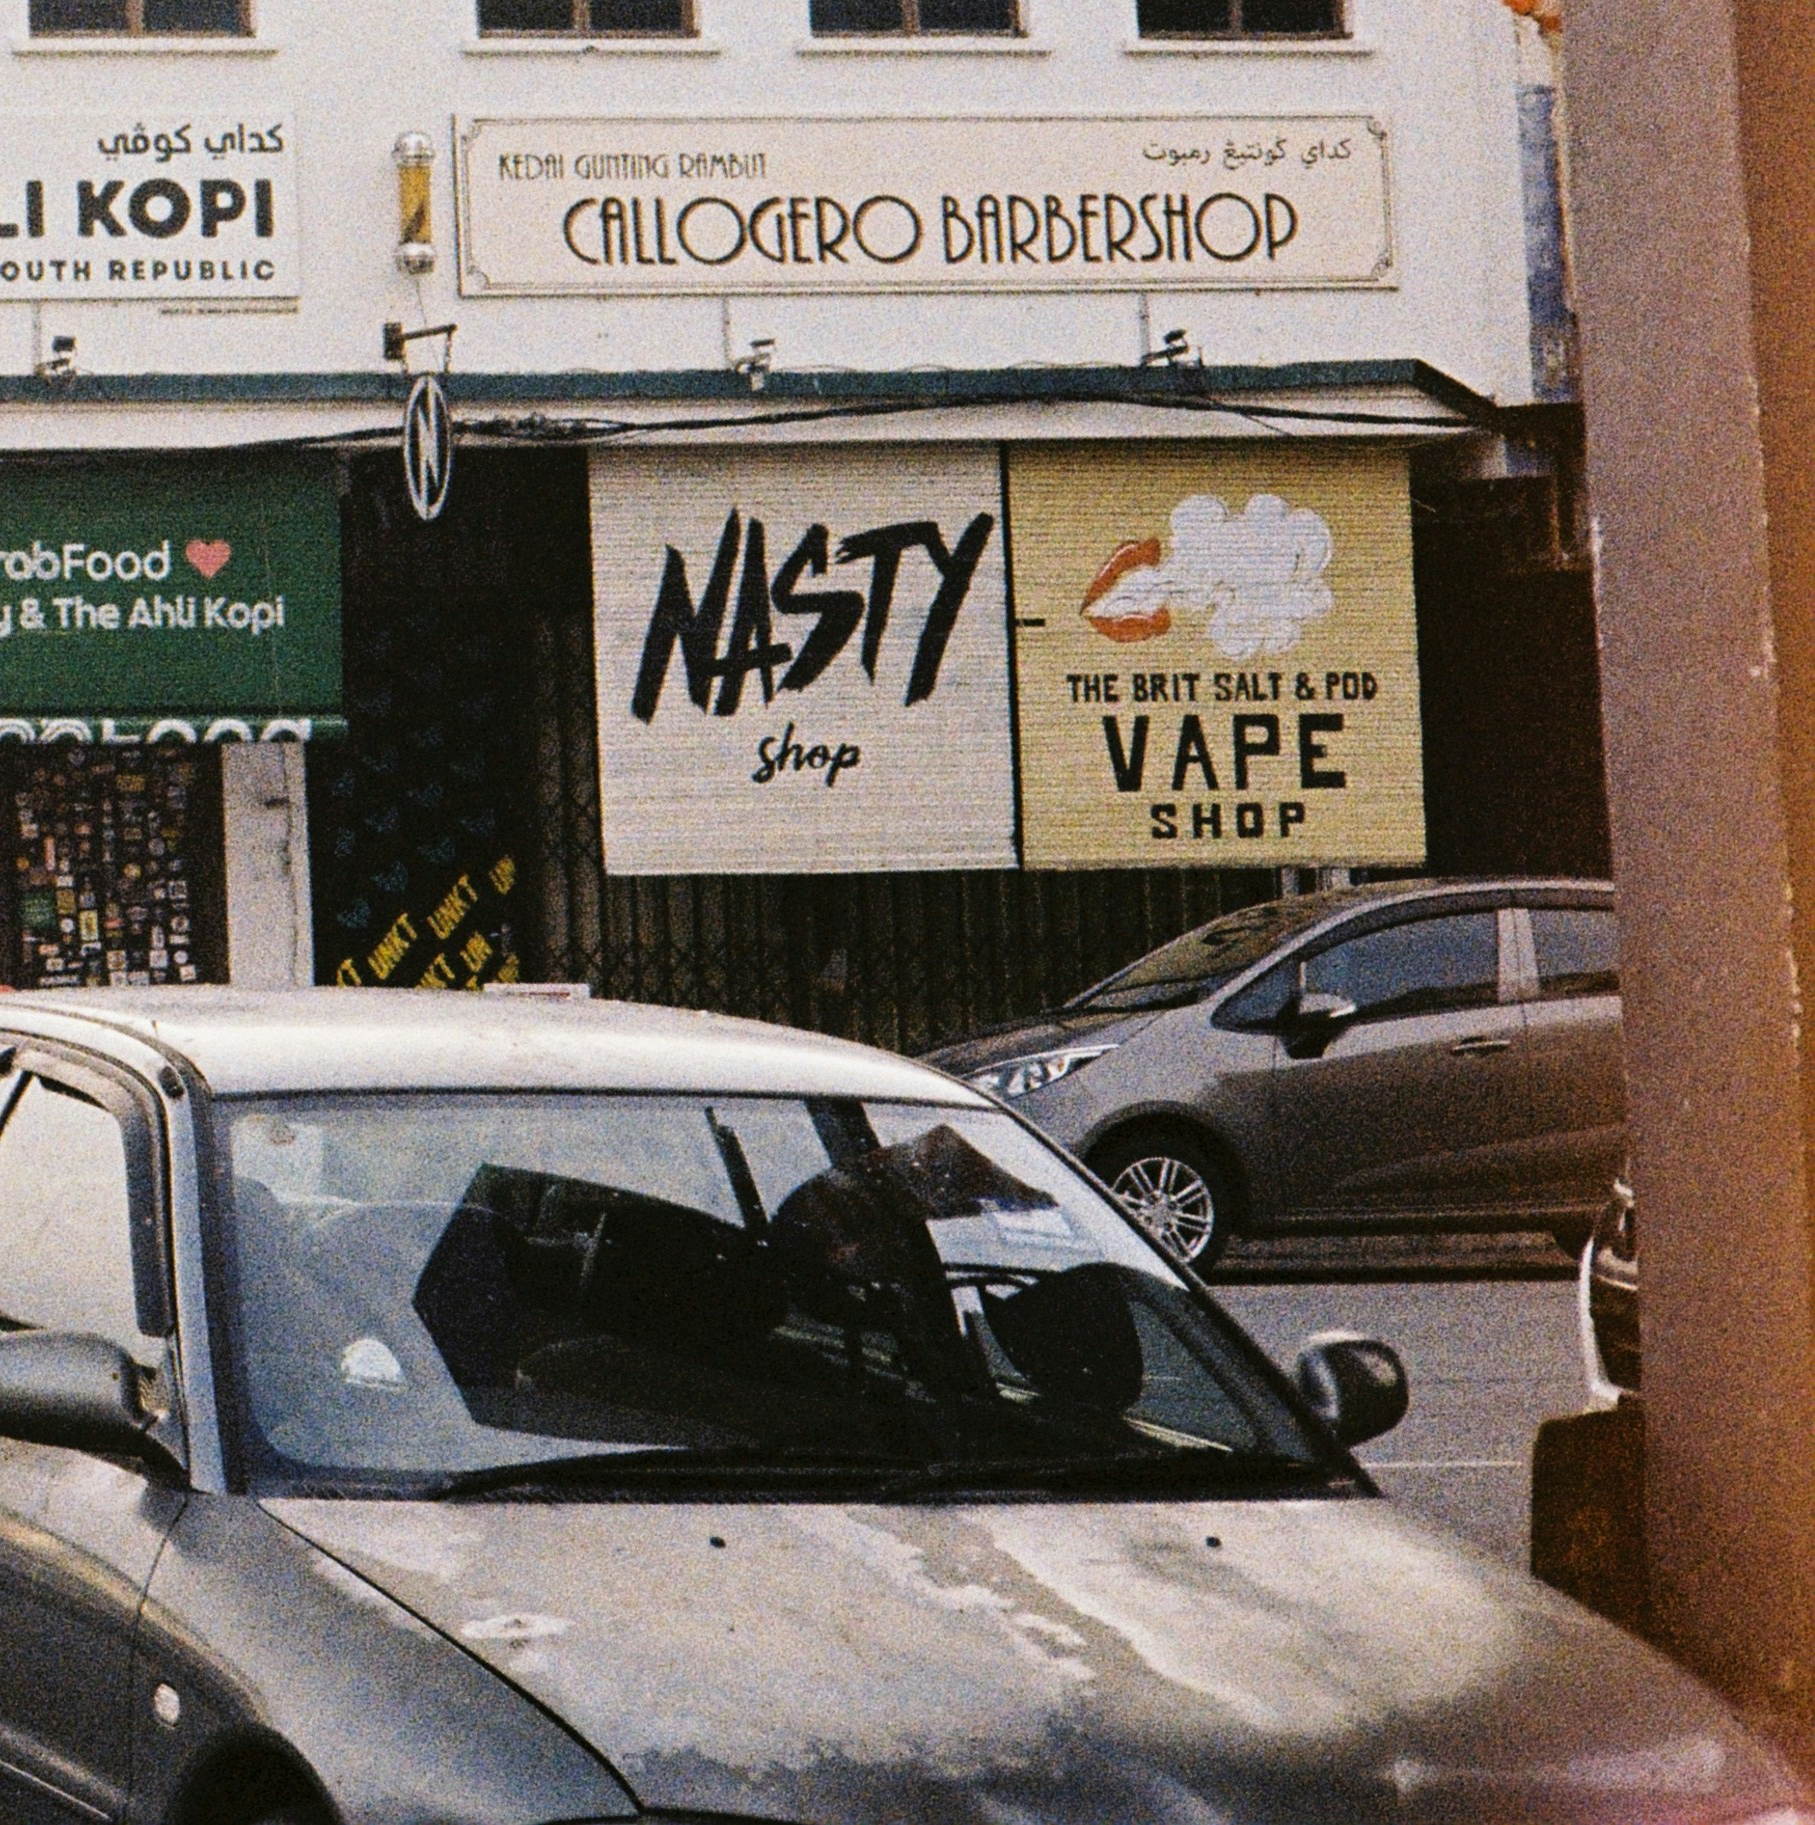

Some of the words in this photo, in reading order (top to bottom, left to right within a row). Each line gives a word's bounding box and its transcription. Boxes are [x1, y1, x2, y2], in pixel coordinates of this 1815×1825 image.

[498, 153, 565, 181] KEDAI
[574, 153, 670, 181] GUNTING
[76, 177, 275, 240] KOPI
[563, 195, 924, 267] CALLOGERO
[941, 192, 1299, 264] BARBERSHOP
[108, 259, 275, 282] REPUBLIC
[19, 597, 45, 630] &
[51, 595, 121, 629] The
[128, 594, 197, 629] Ahli
[202, 595, 285, 636] Kopi
[632, 507, 994, 724] NASTY
[1067, 673, 1119, 702] THE
[1132, 673, 1200, 702] BRIT
[1214, 673, 1281, 701] SALT
[1295, 673, 1316, 700] &
[1326, 672, 1377, 700] POD
[751, 722, 862, 788] shop
[1101, 713, 1347, 793] VAPE
[1150, 802, 1306, 840] SHOP
